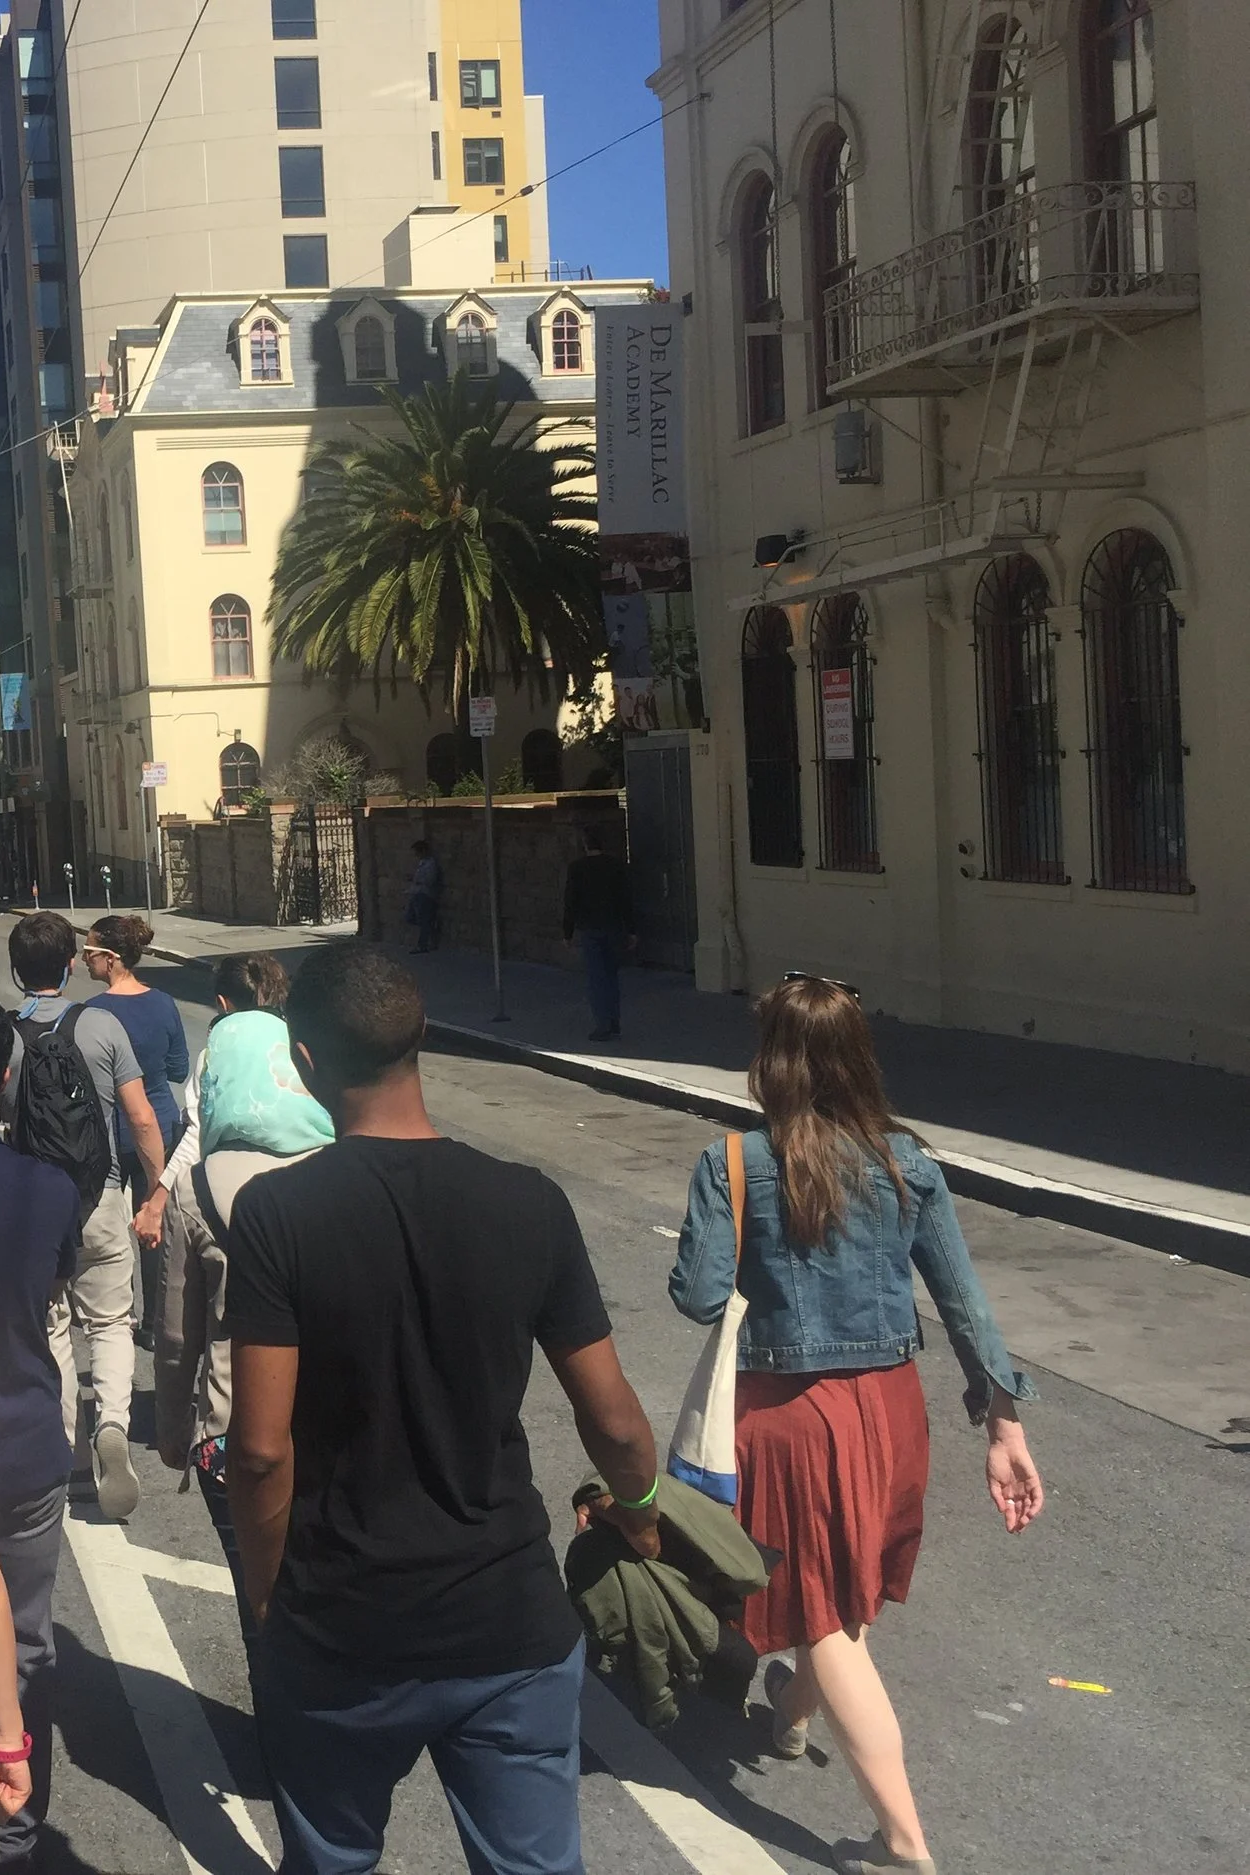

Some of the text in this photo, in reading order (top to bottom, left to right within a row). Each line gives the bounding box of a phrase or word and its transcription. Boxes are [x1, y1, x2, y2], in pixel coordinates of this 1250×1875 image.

[626, 326, 645, 438] ACADEMY
[650, 324, 671, 504] DE MARILLAC
